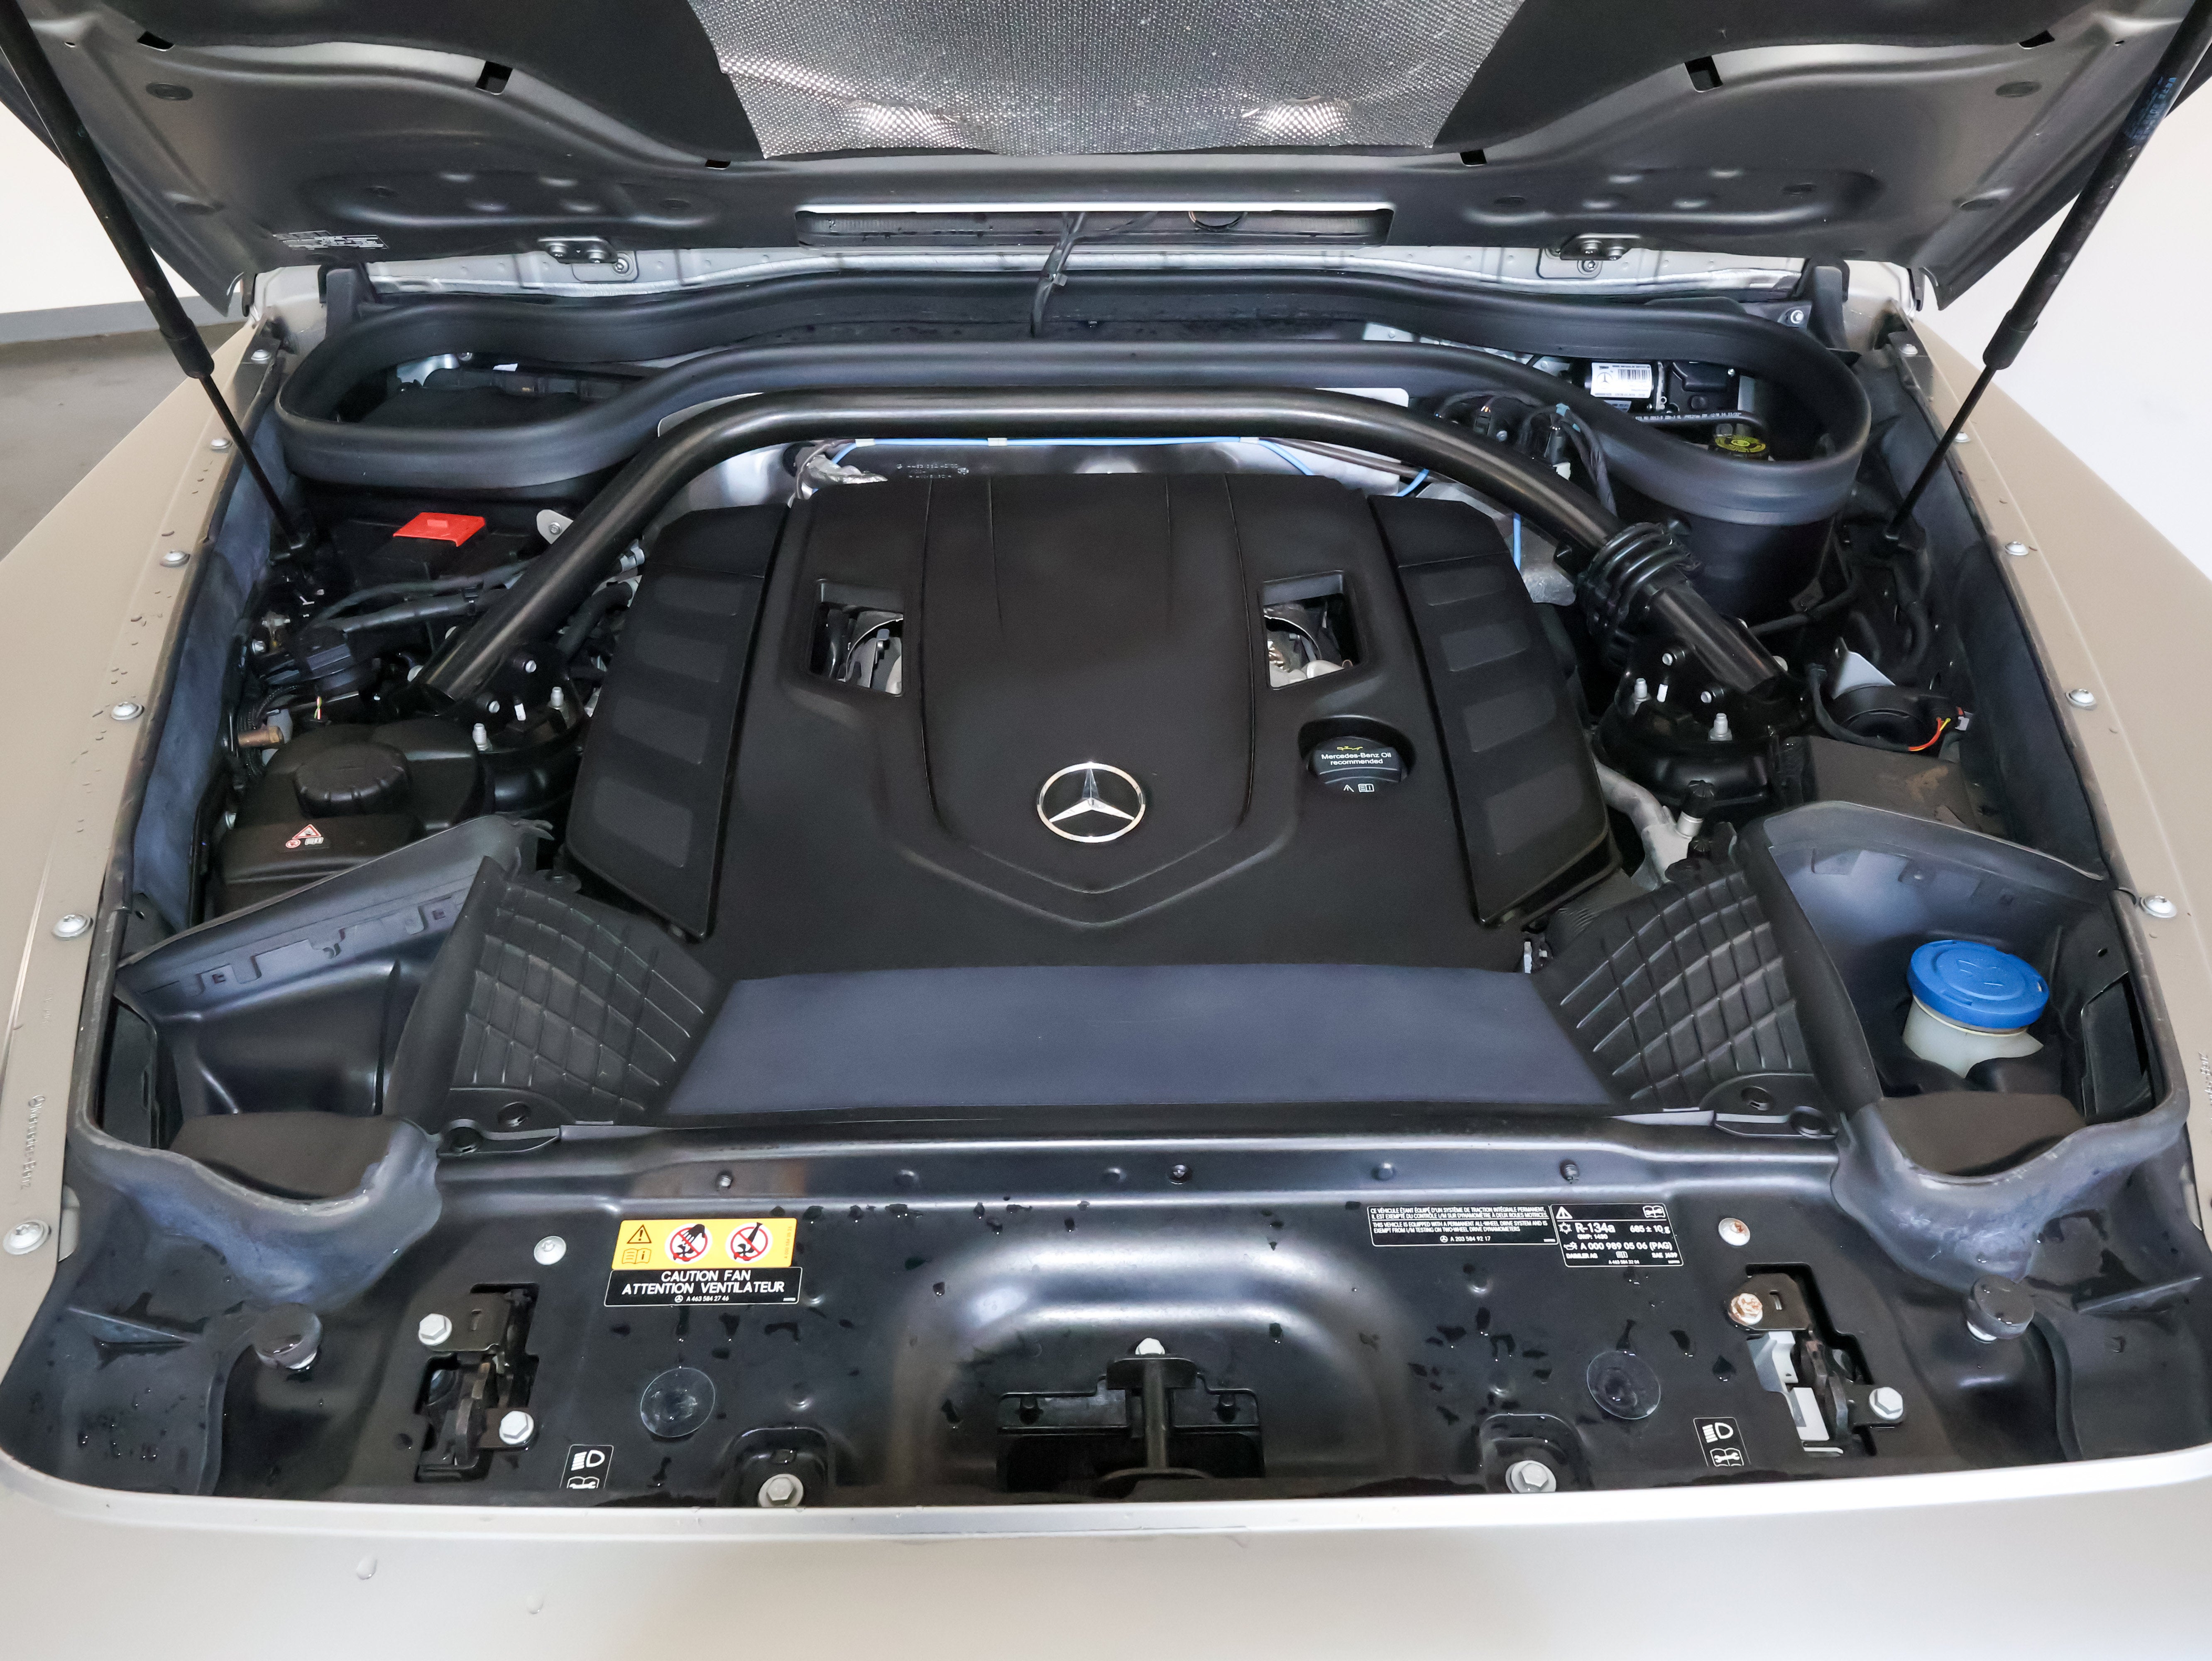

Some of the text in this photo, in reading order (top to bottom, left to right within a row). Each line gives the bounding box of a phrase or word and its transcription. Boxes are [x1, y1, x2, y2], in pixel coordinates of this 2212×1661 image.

[21, 1105, 42, 1190] Mercedes-Benz
[1575, 1222, 1616, 1233] R-134a
[1649, 1242, 1672, 1251] (PAG)
[661, 1270, 751, 1282] CAUTION FAN
[622, 1281, 785, 1295] ATTENTION VENTILATEUR
